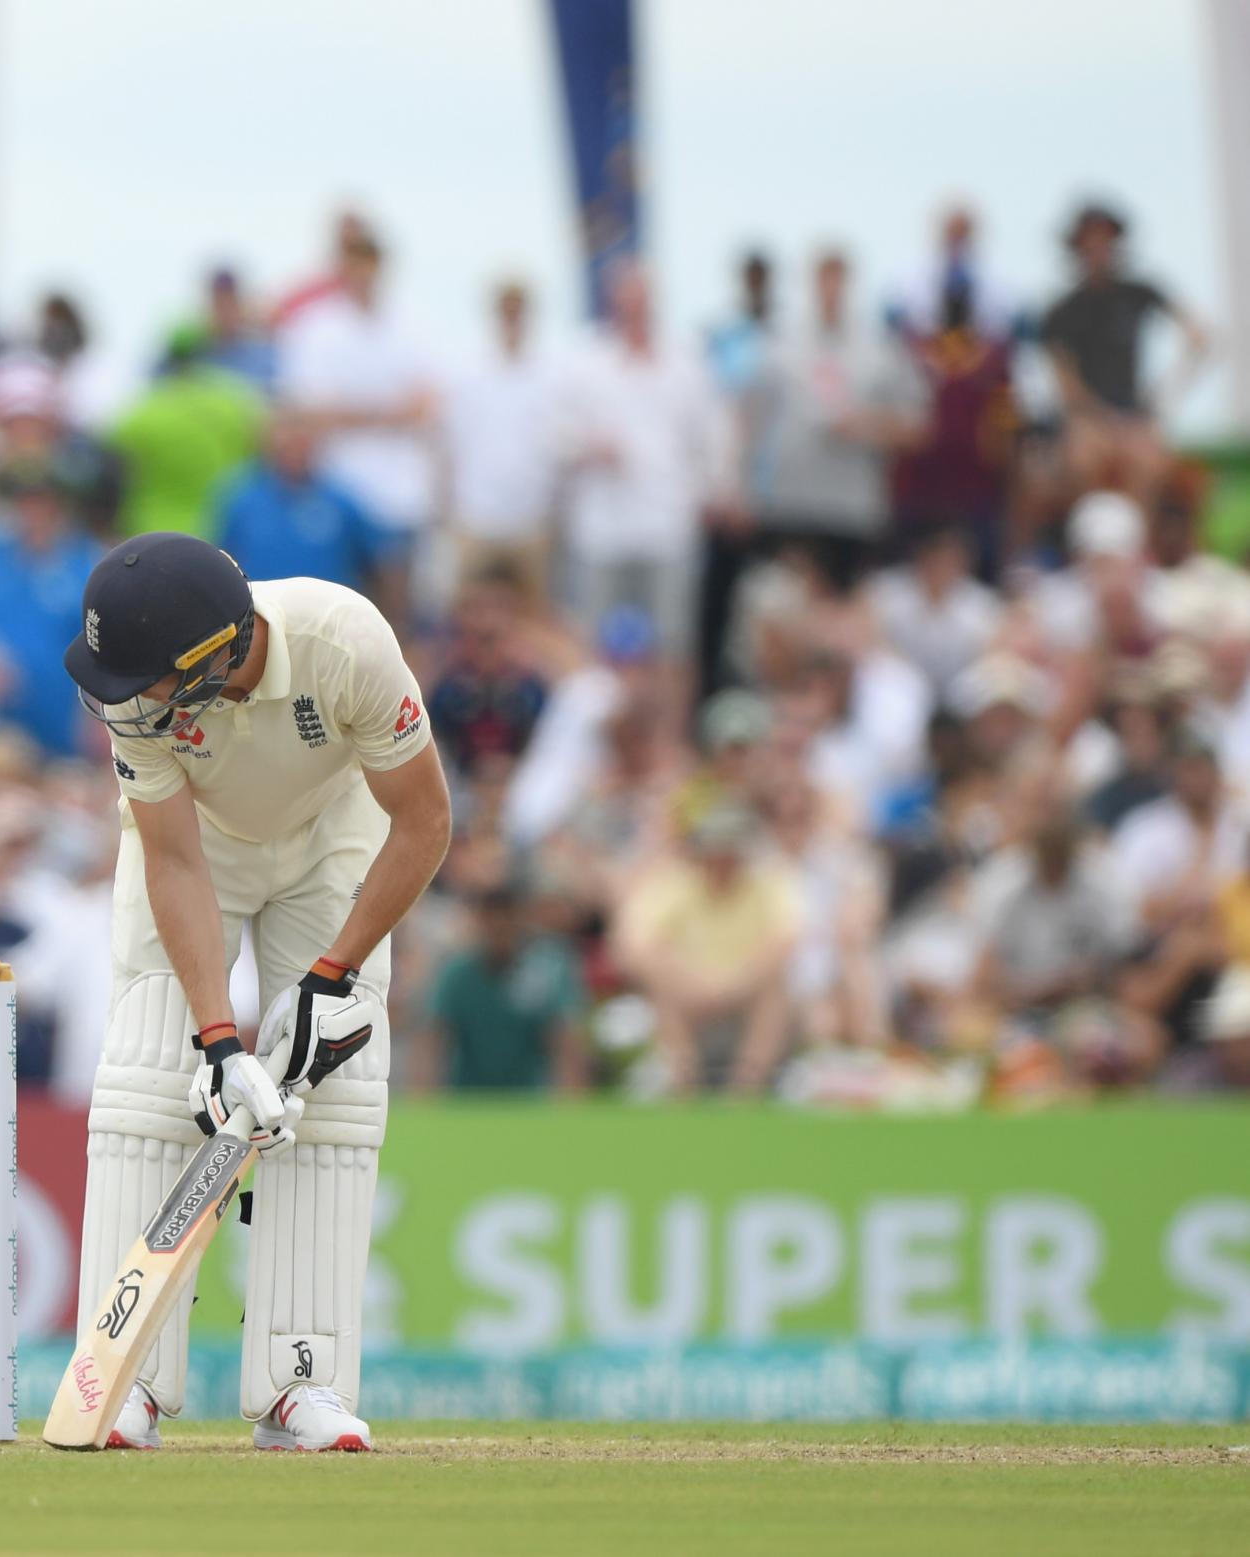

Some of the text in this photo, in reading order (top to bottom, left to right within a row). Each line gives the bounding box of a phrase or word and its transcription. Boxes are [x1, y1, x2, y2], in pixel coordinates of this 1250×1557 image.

[170, 743, 214, 759] Natest
[153, 1142, 238, 1248] KOOKABURRA
[452, 1190, 1104, 1350] SUPER
[72, 1351, 104, 1413] Vitality
